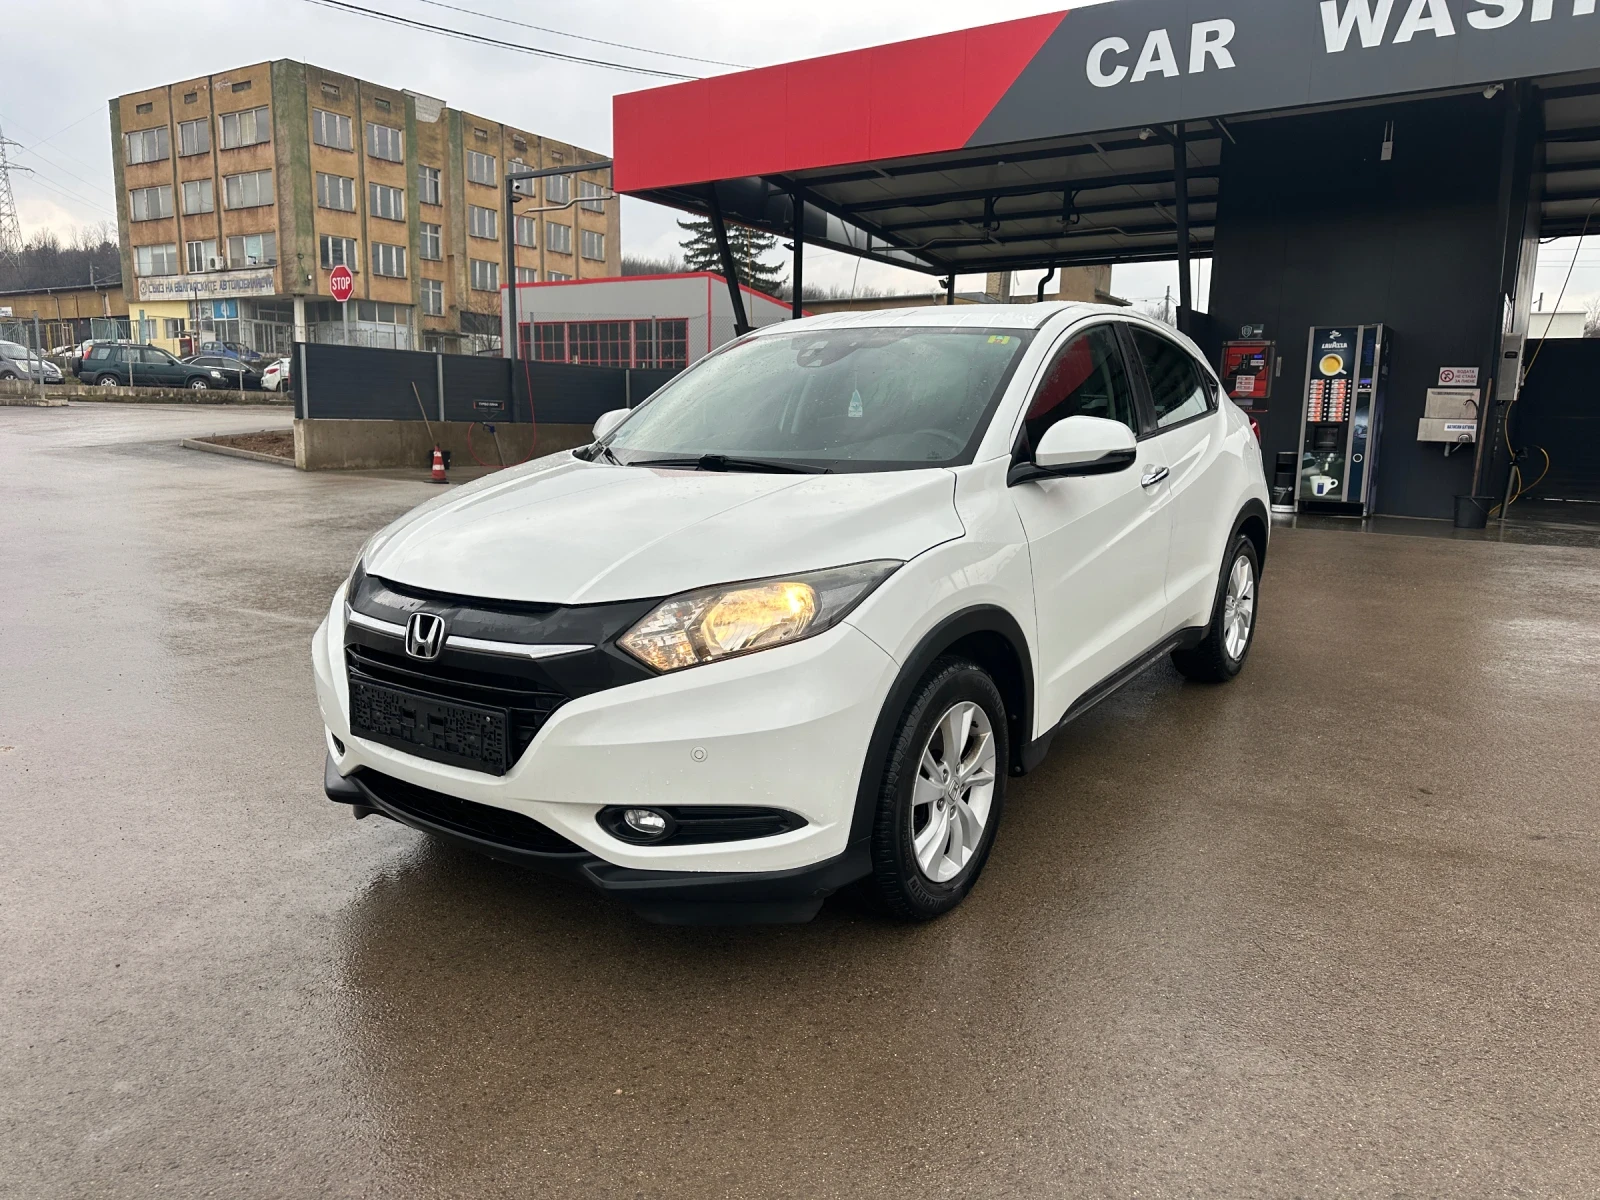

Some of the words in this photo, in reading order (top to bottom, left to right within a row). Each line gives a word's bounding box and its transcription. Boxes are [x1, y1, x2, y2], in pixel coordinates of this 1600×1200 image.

[1086, 18, 1236, 88] CAR
[165, 281, 174, 293] НА
[332, 277, 351, 291] STOP
[1321, 341, 1347, 349] LAVAZZA
